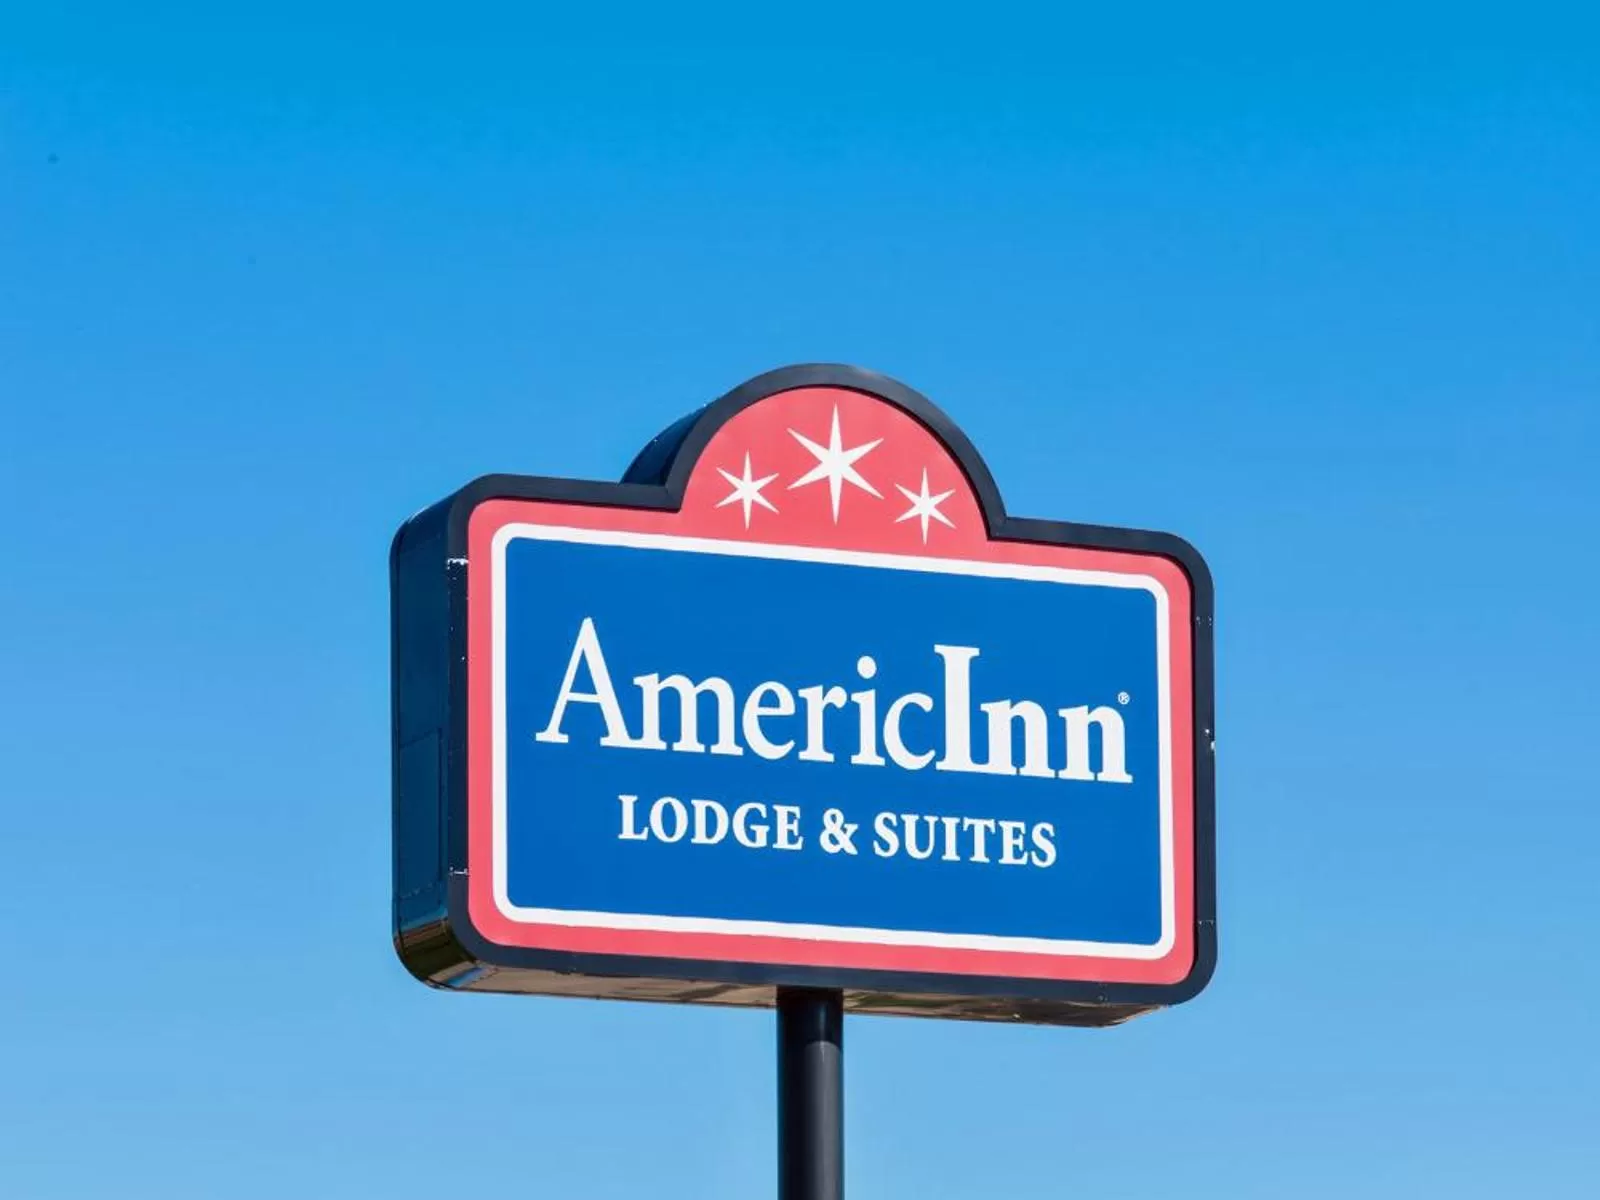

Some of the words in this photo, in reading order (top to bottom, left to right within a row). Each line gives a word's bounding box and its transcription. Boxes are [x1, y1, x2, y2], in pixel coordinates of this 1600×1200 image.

[535, 616, 1133, 784] AmericInn
[618, 794, 804, 850] LODGE
[819, 808, 858, 855] &
[873, 812, 1057, 868] SUITES
